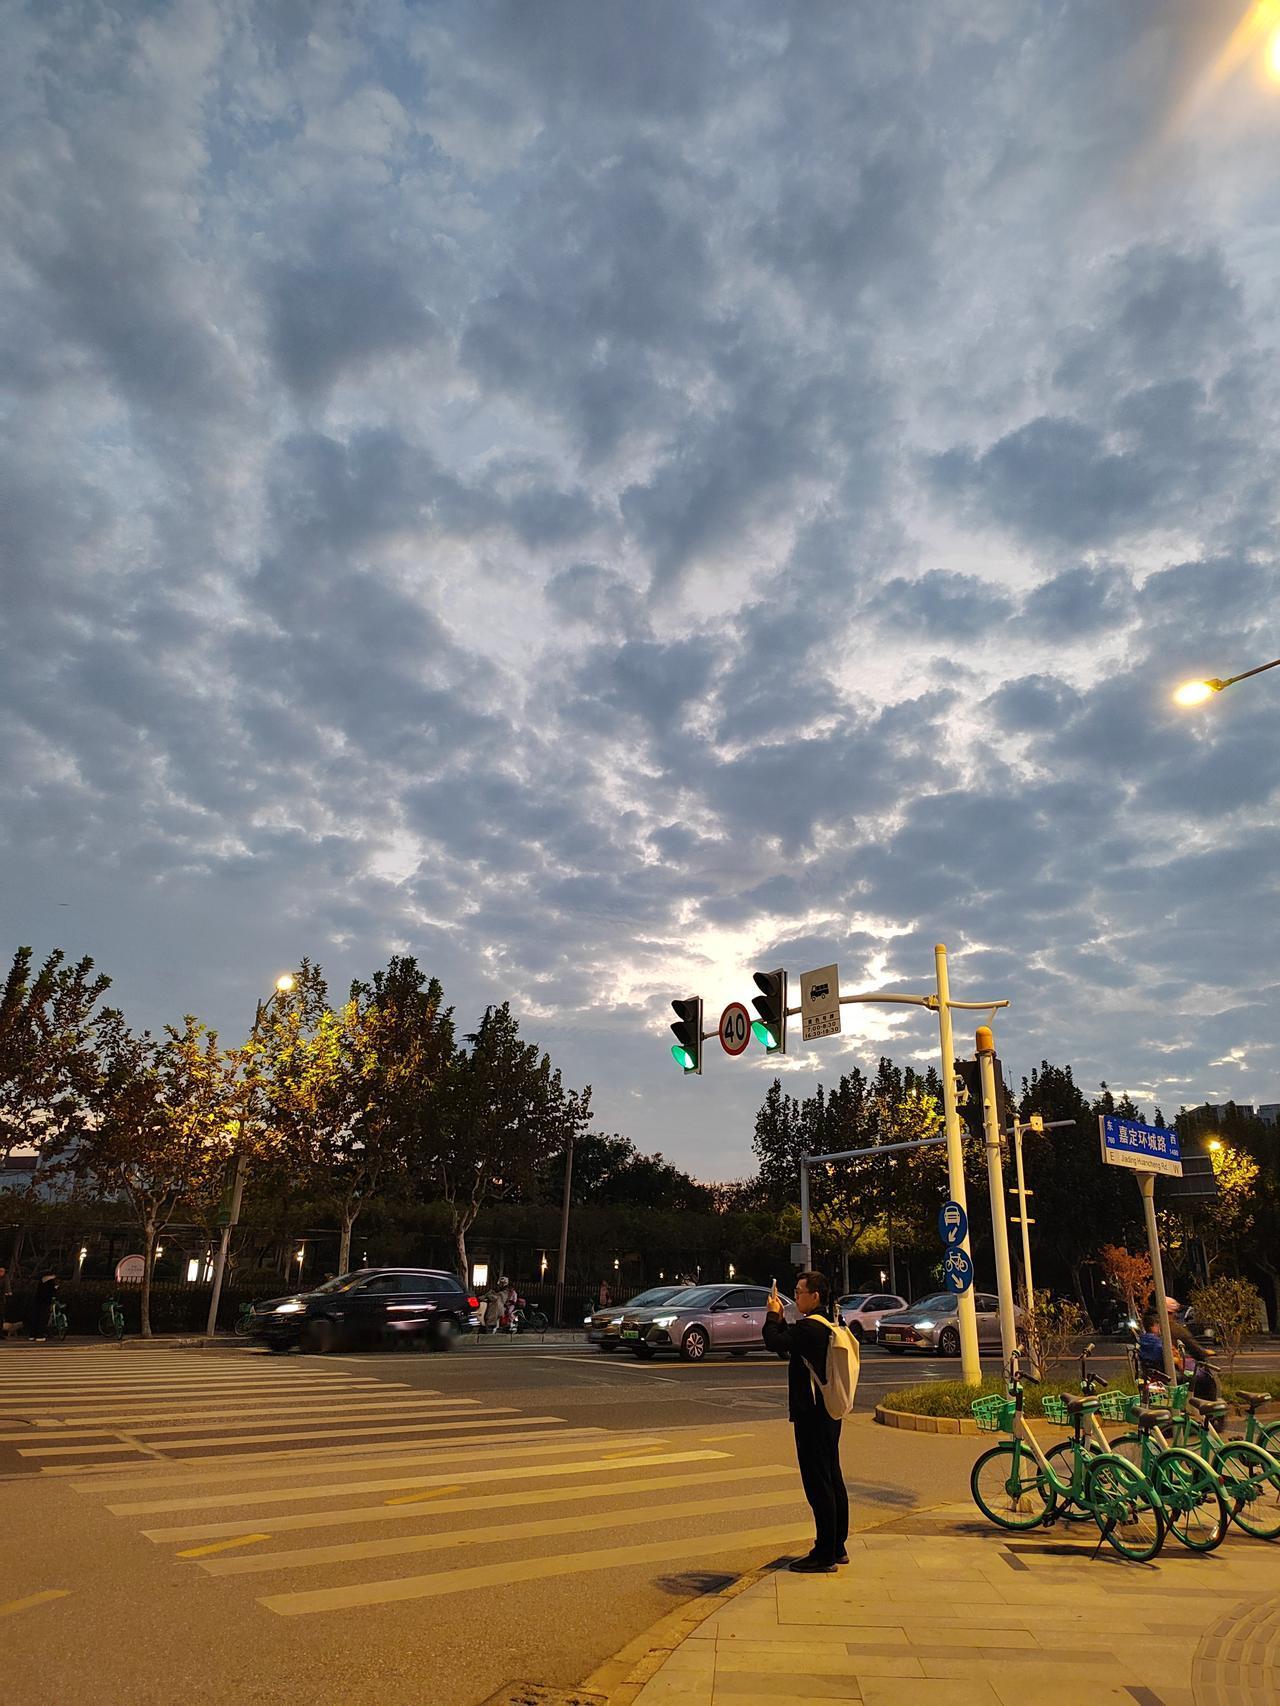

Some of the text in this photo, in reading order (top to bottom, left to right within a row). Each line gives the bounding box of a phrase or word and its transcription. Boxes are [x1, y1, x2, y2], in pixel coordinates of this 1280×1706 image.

[725, 1014, 745, 1042] 40
[1107, 1120, 1113, 1131] 东
[1119, 1126, 1166, 1152] 嘉定环城路
[1170, 1134, 1176, 1144] 西
[1110, 1151, 1115, 1161] E
[1173, 1163, 1180, 1174] W
